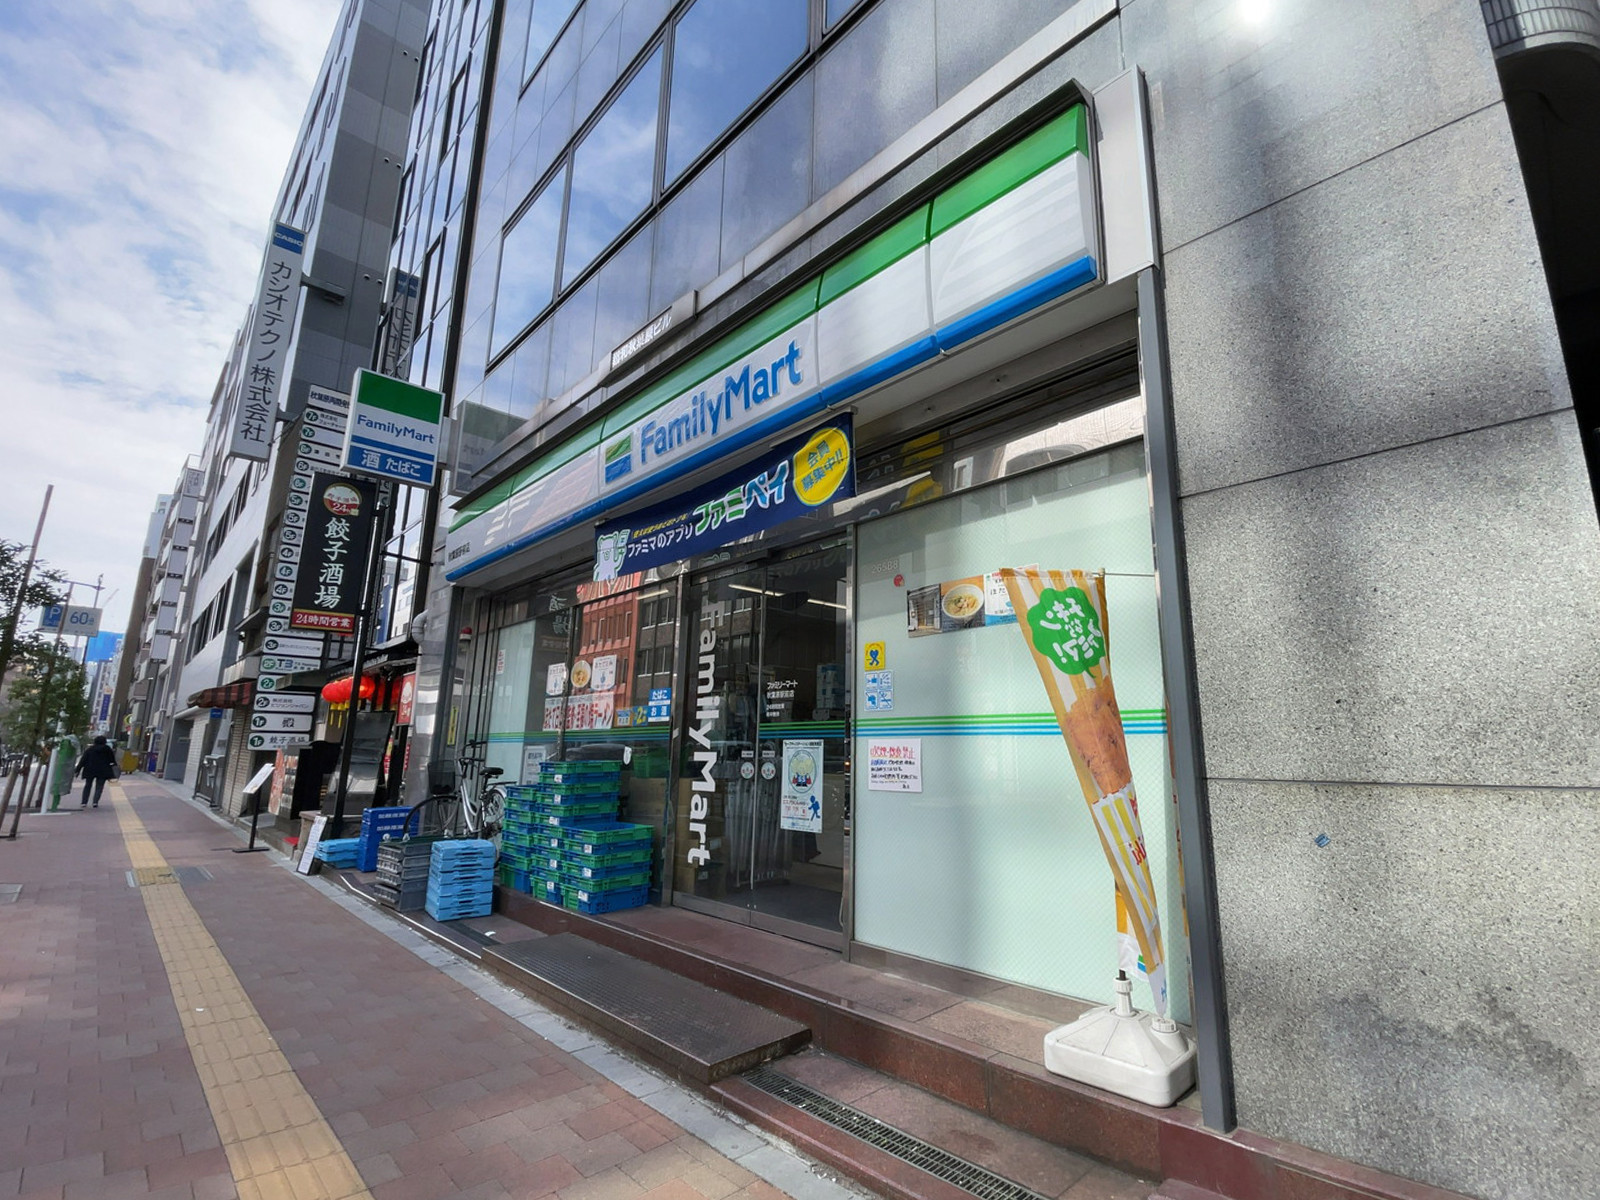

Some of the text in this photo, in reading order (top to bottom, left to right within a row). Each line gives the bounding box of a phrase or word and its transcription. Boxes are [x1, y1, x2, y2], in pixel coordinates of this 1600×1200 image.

[274, 231, 304, 247] CASIO
[241, 261, 292, 443] カシオテクノ株式会社
[641, 340, 802, 464] FamilyMart
[357, 414, 435, 444] FamilyMart
[361, 450, 380, 469] 酒
[385, 458, 421, 477] たばこ
[808, 440, 830, 468] 会員
[692, 460, 790, 536] ファミペイ
[628, 523, 693, 558] ファミマのアプリ
[281, 567, 291, 577] 4F
[314, 517, 350, 609] 餃子酒場
[50, 607, 60, 619] P
[295, 614, 350, 627] 24時間営業
[262, 677, 274, 689] 2F
[767, 679, 798, 690] ファミリーマート
[652, 690, 667, 700] たばこ
[254, 717, 265, 726] 1F
[688, 594, 726, 865] FamilyMart
[251, 736, 263, 746] 1F
